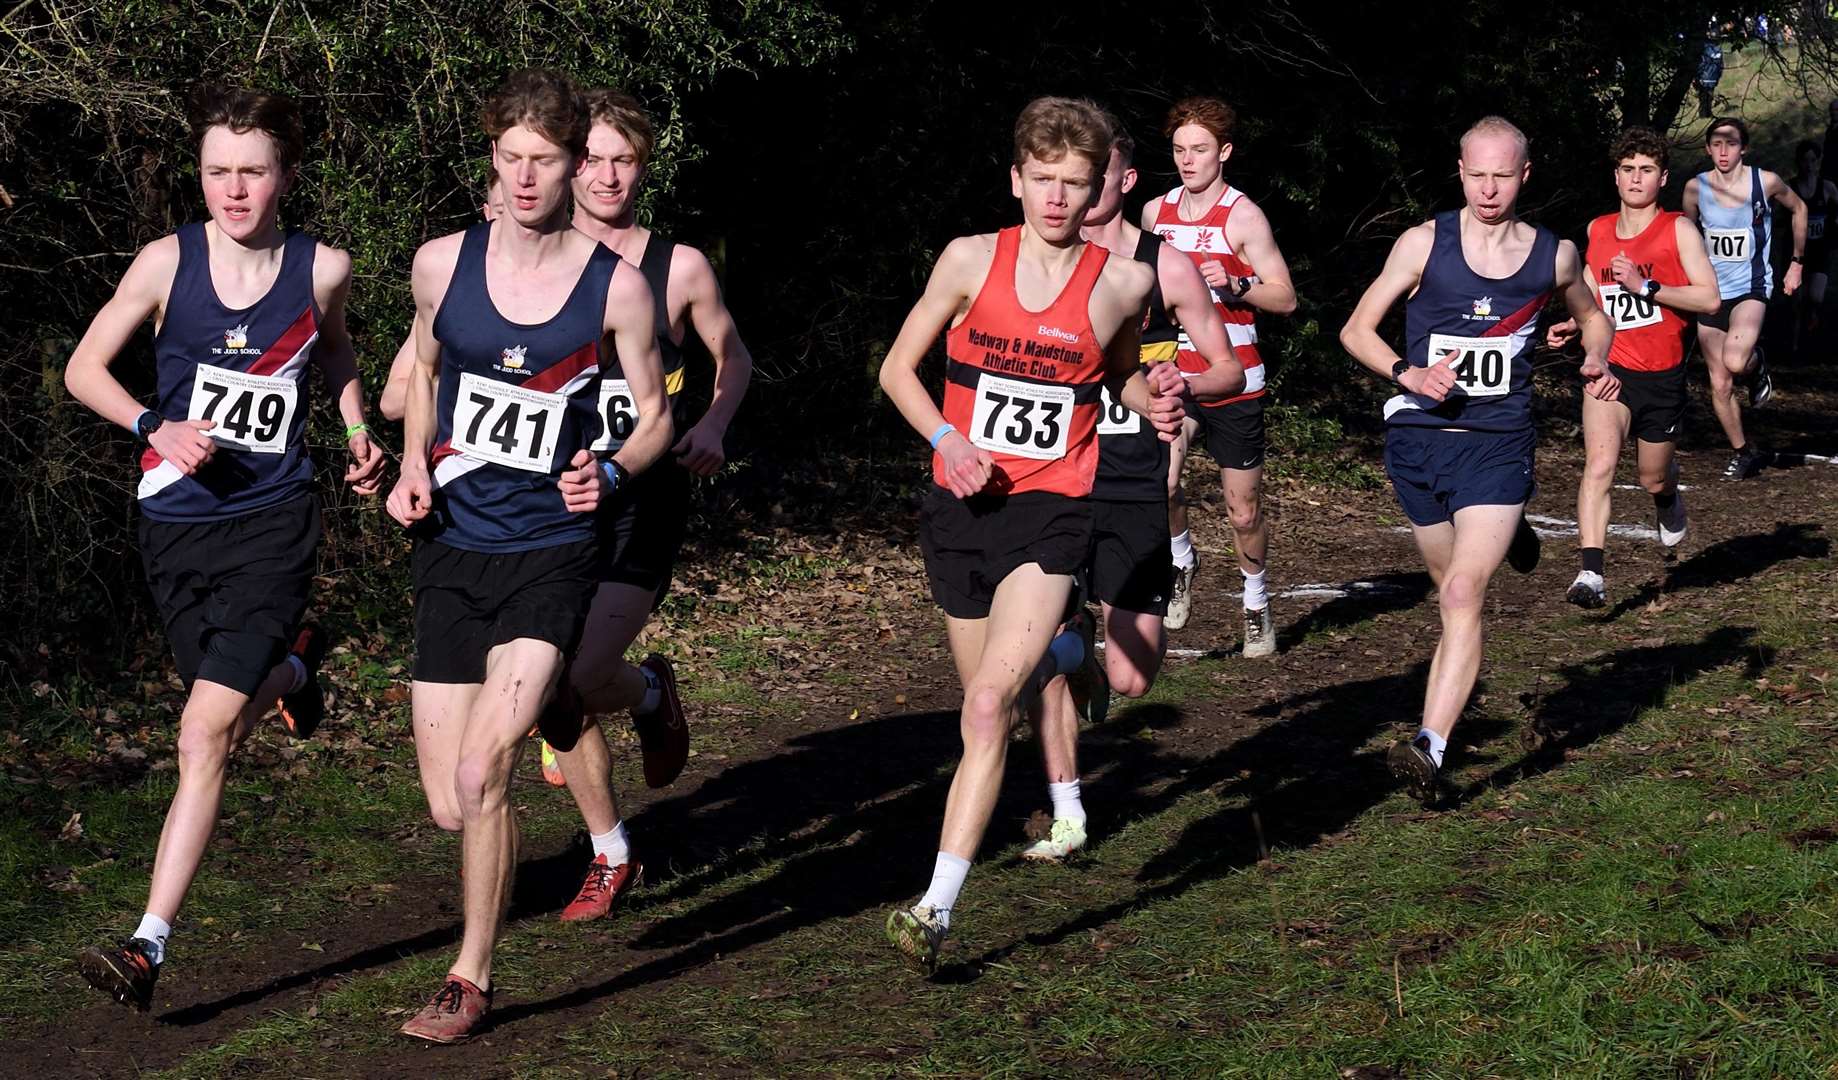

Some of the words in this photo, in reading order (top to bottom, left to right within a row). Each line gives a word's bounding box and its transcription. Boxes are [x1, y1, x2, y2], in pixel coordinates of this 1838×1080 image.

[1711, 236, 1745, 257] 707
[1605, 293, 1654, 322] 720
[968, 327, 1010, 354] Medway
[1012, 337, 1022, 353] &
[1024, 341, 1084, 365] Maidstone
[1038, 325, 1079, 343] Bellway
[982, 352, 1027, 375] Athletic
[1030, 360, 1057, 379] Club
[201, 381, 286, 443] 749
[466, 392, 549, 459] 741
[983, 391, 1063, 449] 733
